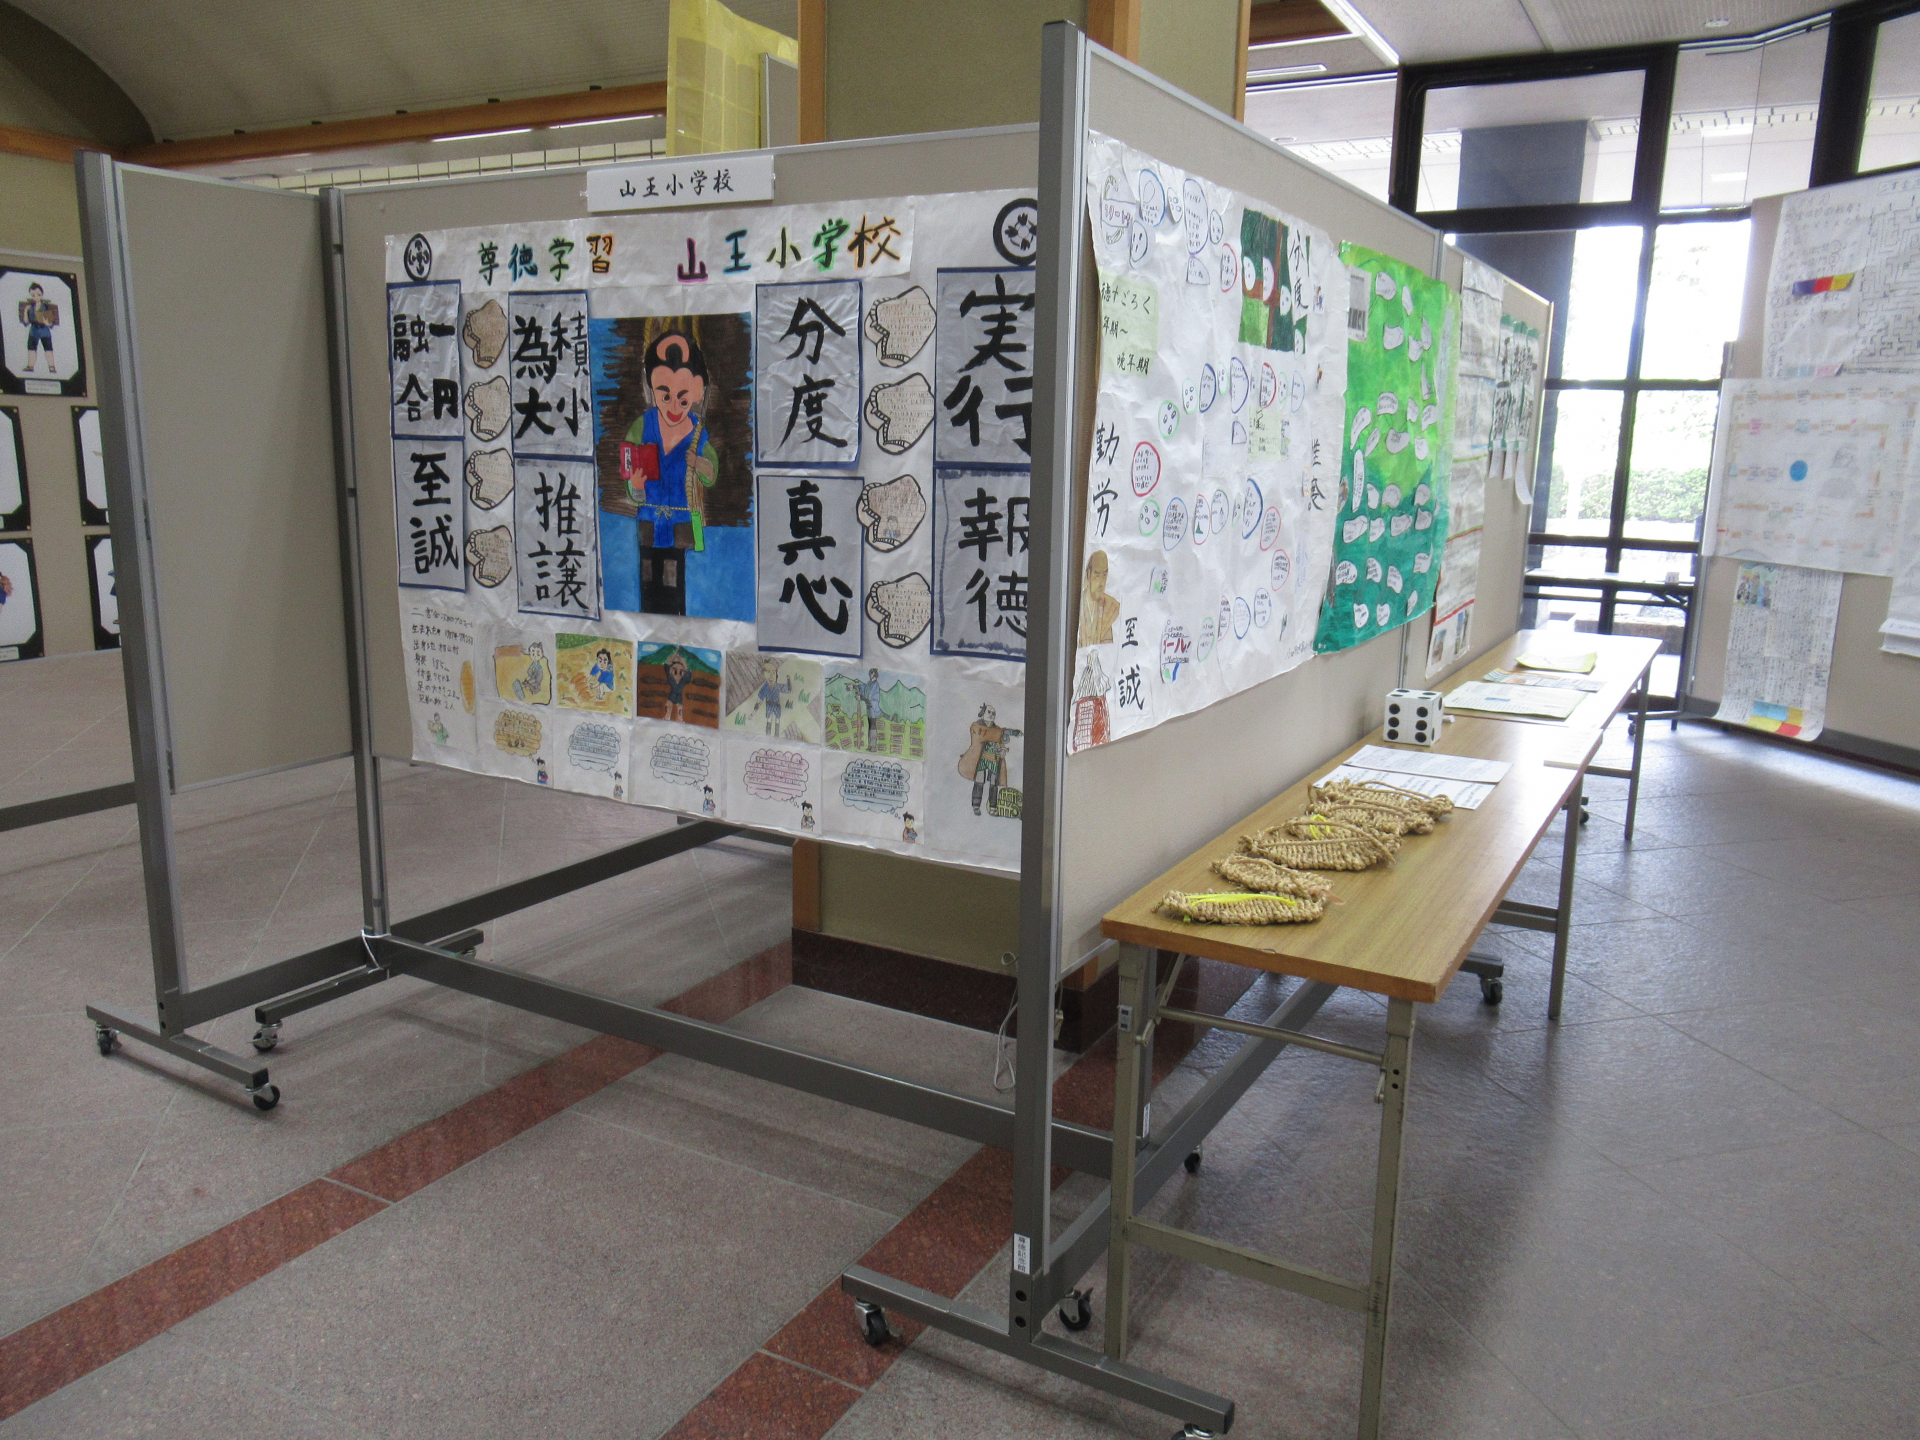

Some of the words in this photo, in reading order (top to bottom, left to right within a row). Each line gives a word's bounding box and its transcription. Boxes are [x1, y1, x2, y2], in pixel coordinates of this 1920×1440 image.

[619, 168, 735, 198] 山王小学校
[477, 233, 615, 286] 尊徳学習
[676, 213, 902, 283] 山王小学校
[1289, 229, 1309, 310] 分度
[778, 296, 848, 449] 分度
[943, 273, 1035, 457] 実行
[410, 451, 459, 575] 至誠
[1092, 422, 1121, 537] 勤労
[528, 471, 590, 610] 推譲
[777, 480, 853, 635] 真心
[1117, 616, 1146, 711] 至誠
